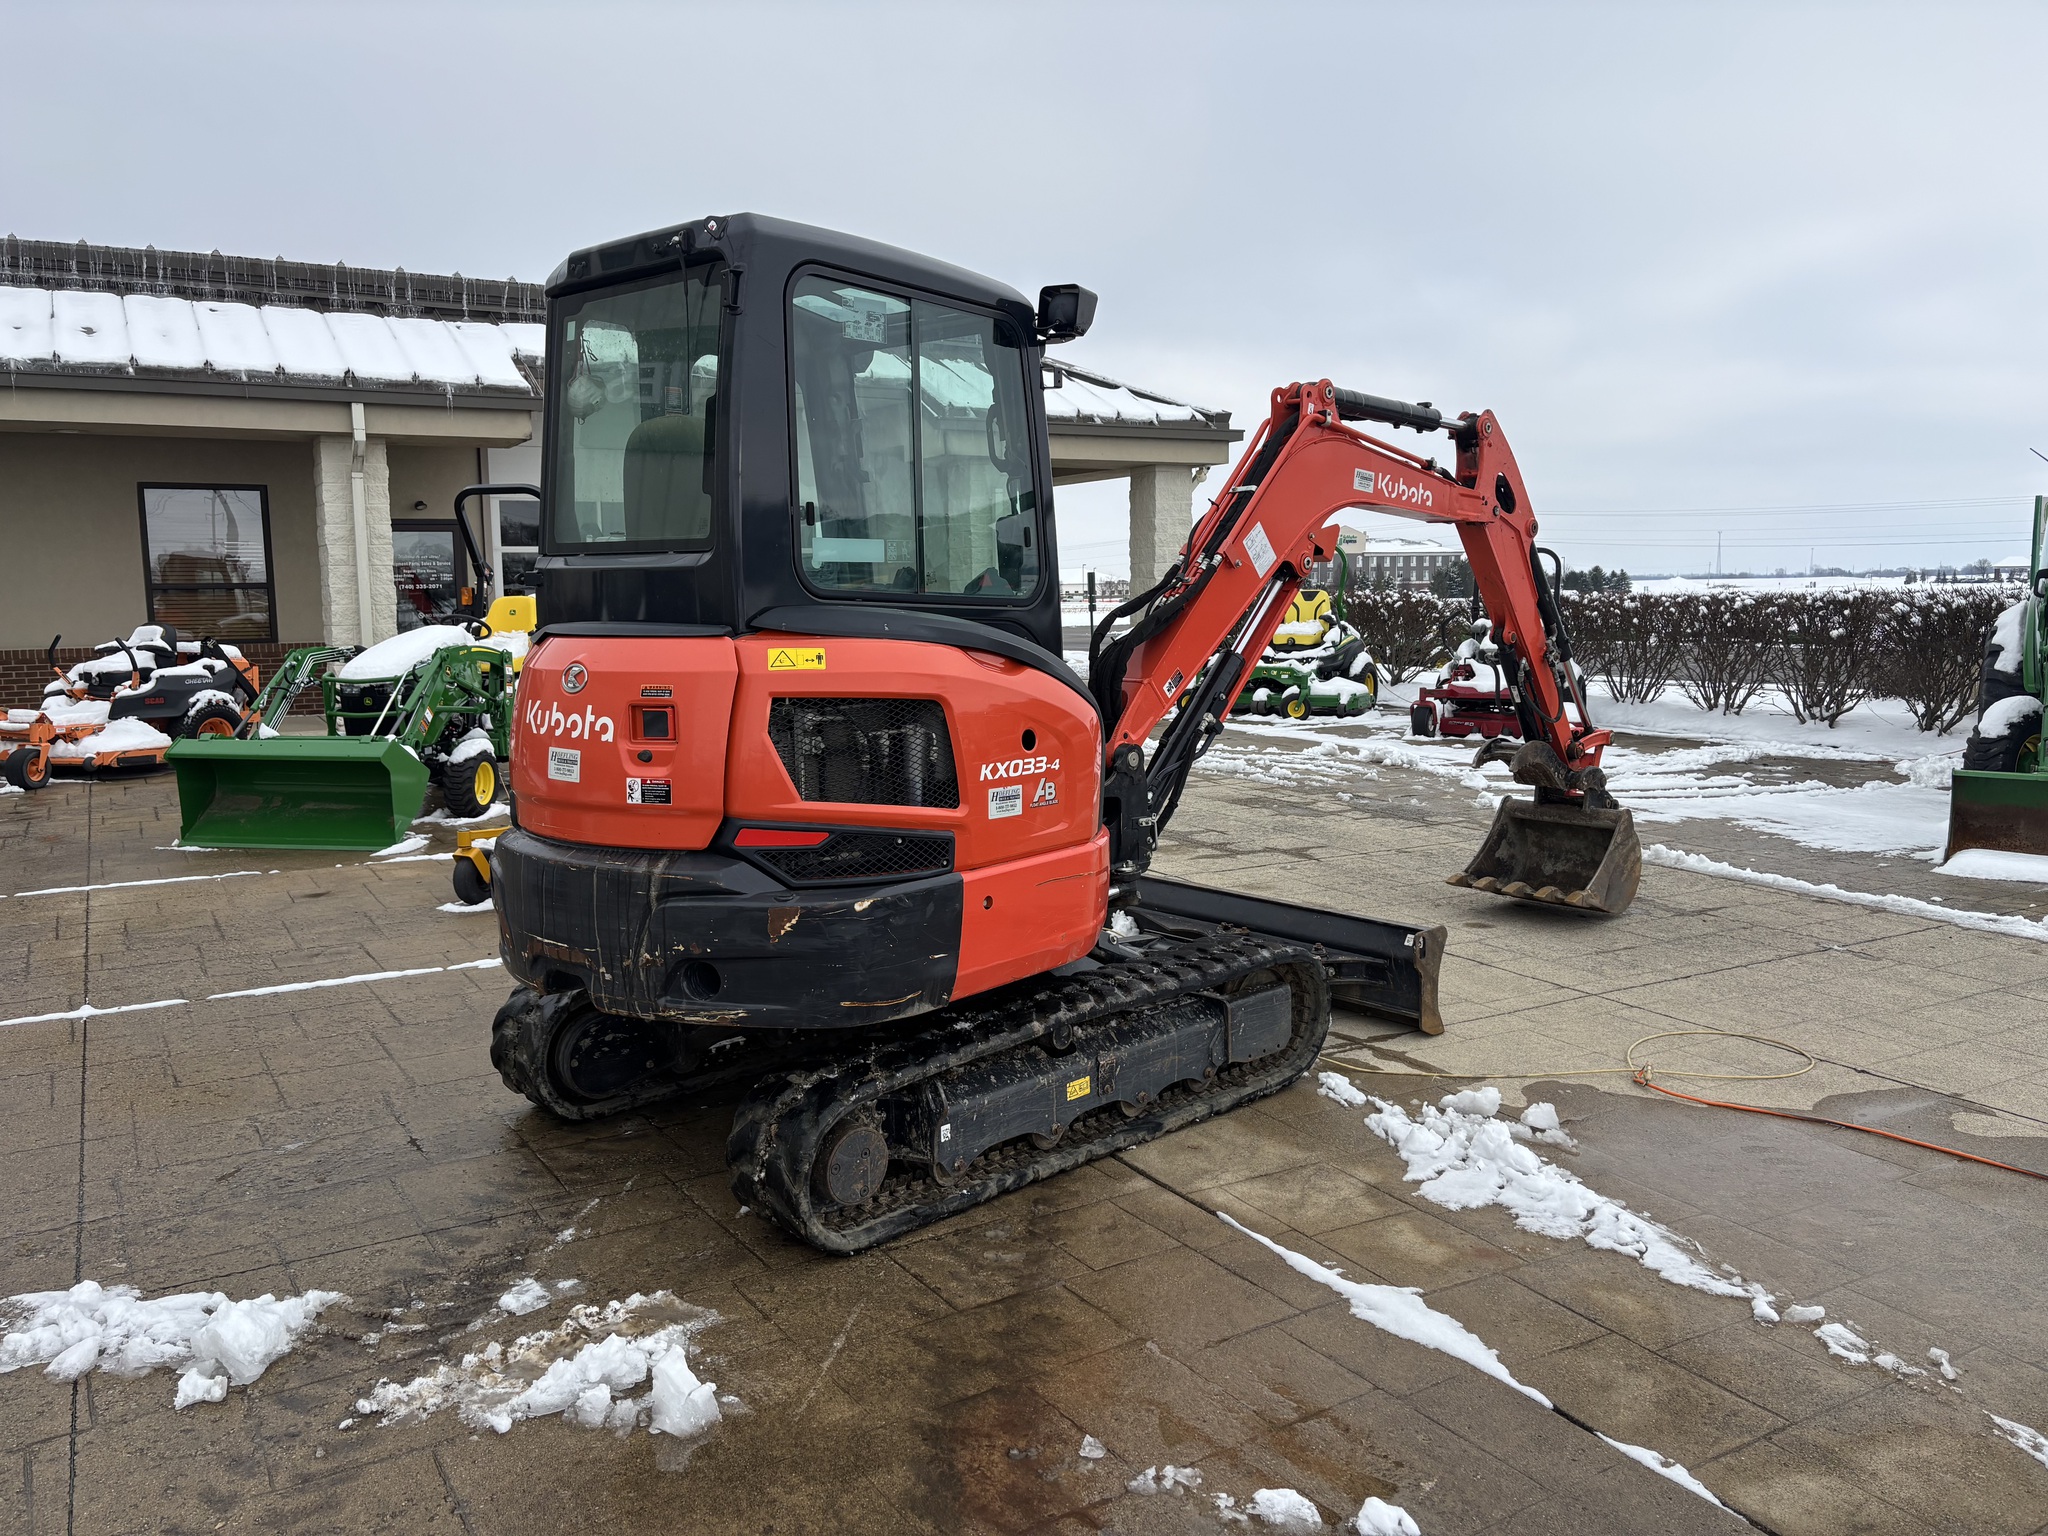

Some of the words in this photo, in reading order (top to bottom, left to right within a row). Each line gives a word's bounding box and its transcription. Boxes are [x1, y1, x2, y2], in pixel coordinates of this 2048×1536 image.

[1378, 472, 1432, 506] Kubota
[185, 677, 213, 685] CHEETAH
[144, 697, 165, 705] SCAG
[525, 699, 615, 742] Kubota
[979, 756, 1060, 781] KX033-4
